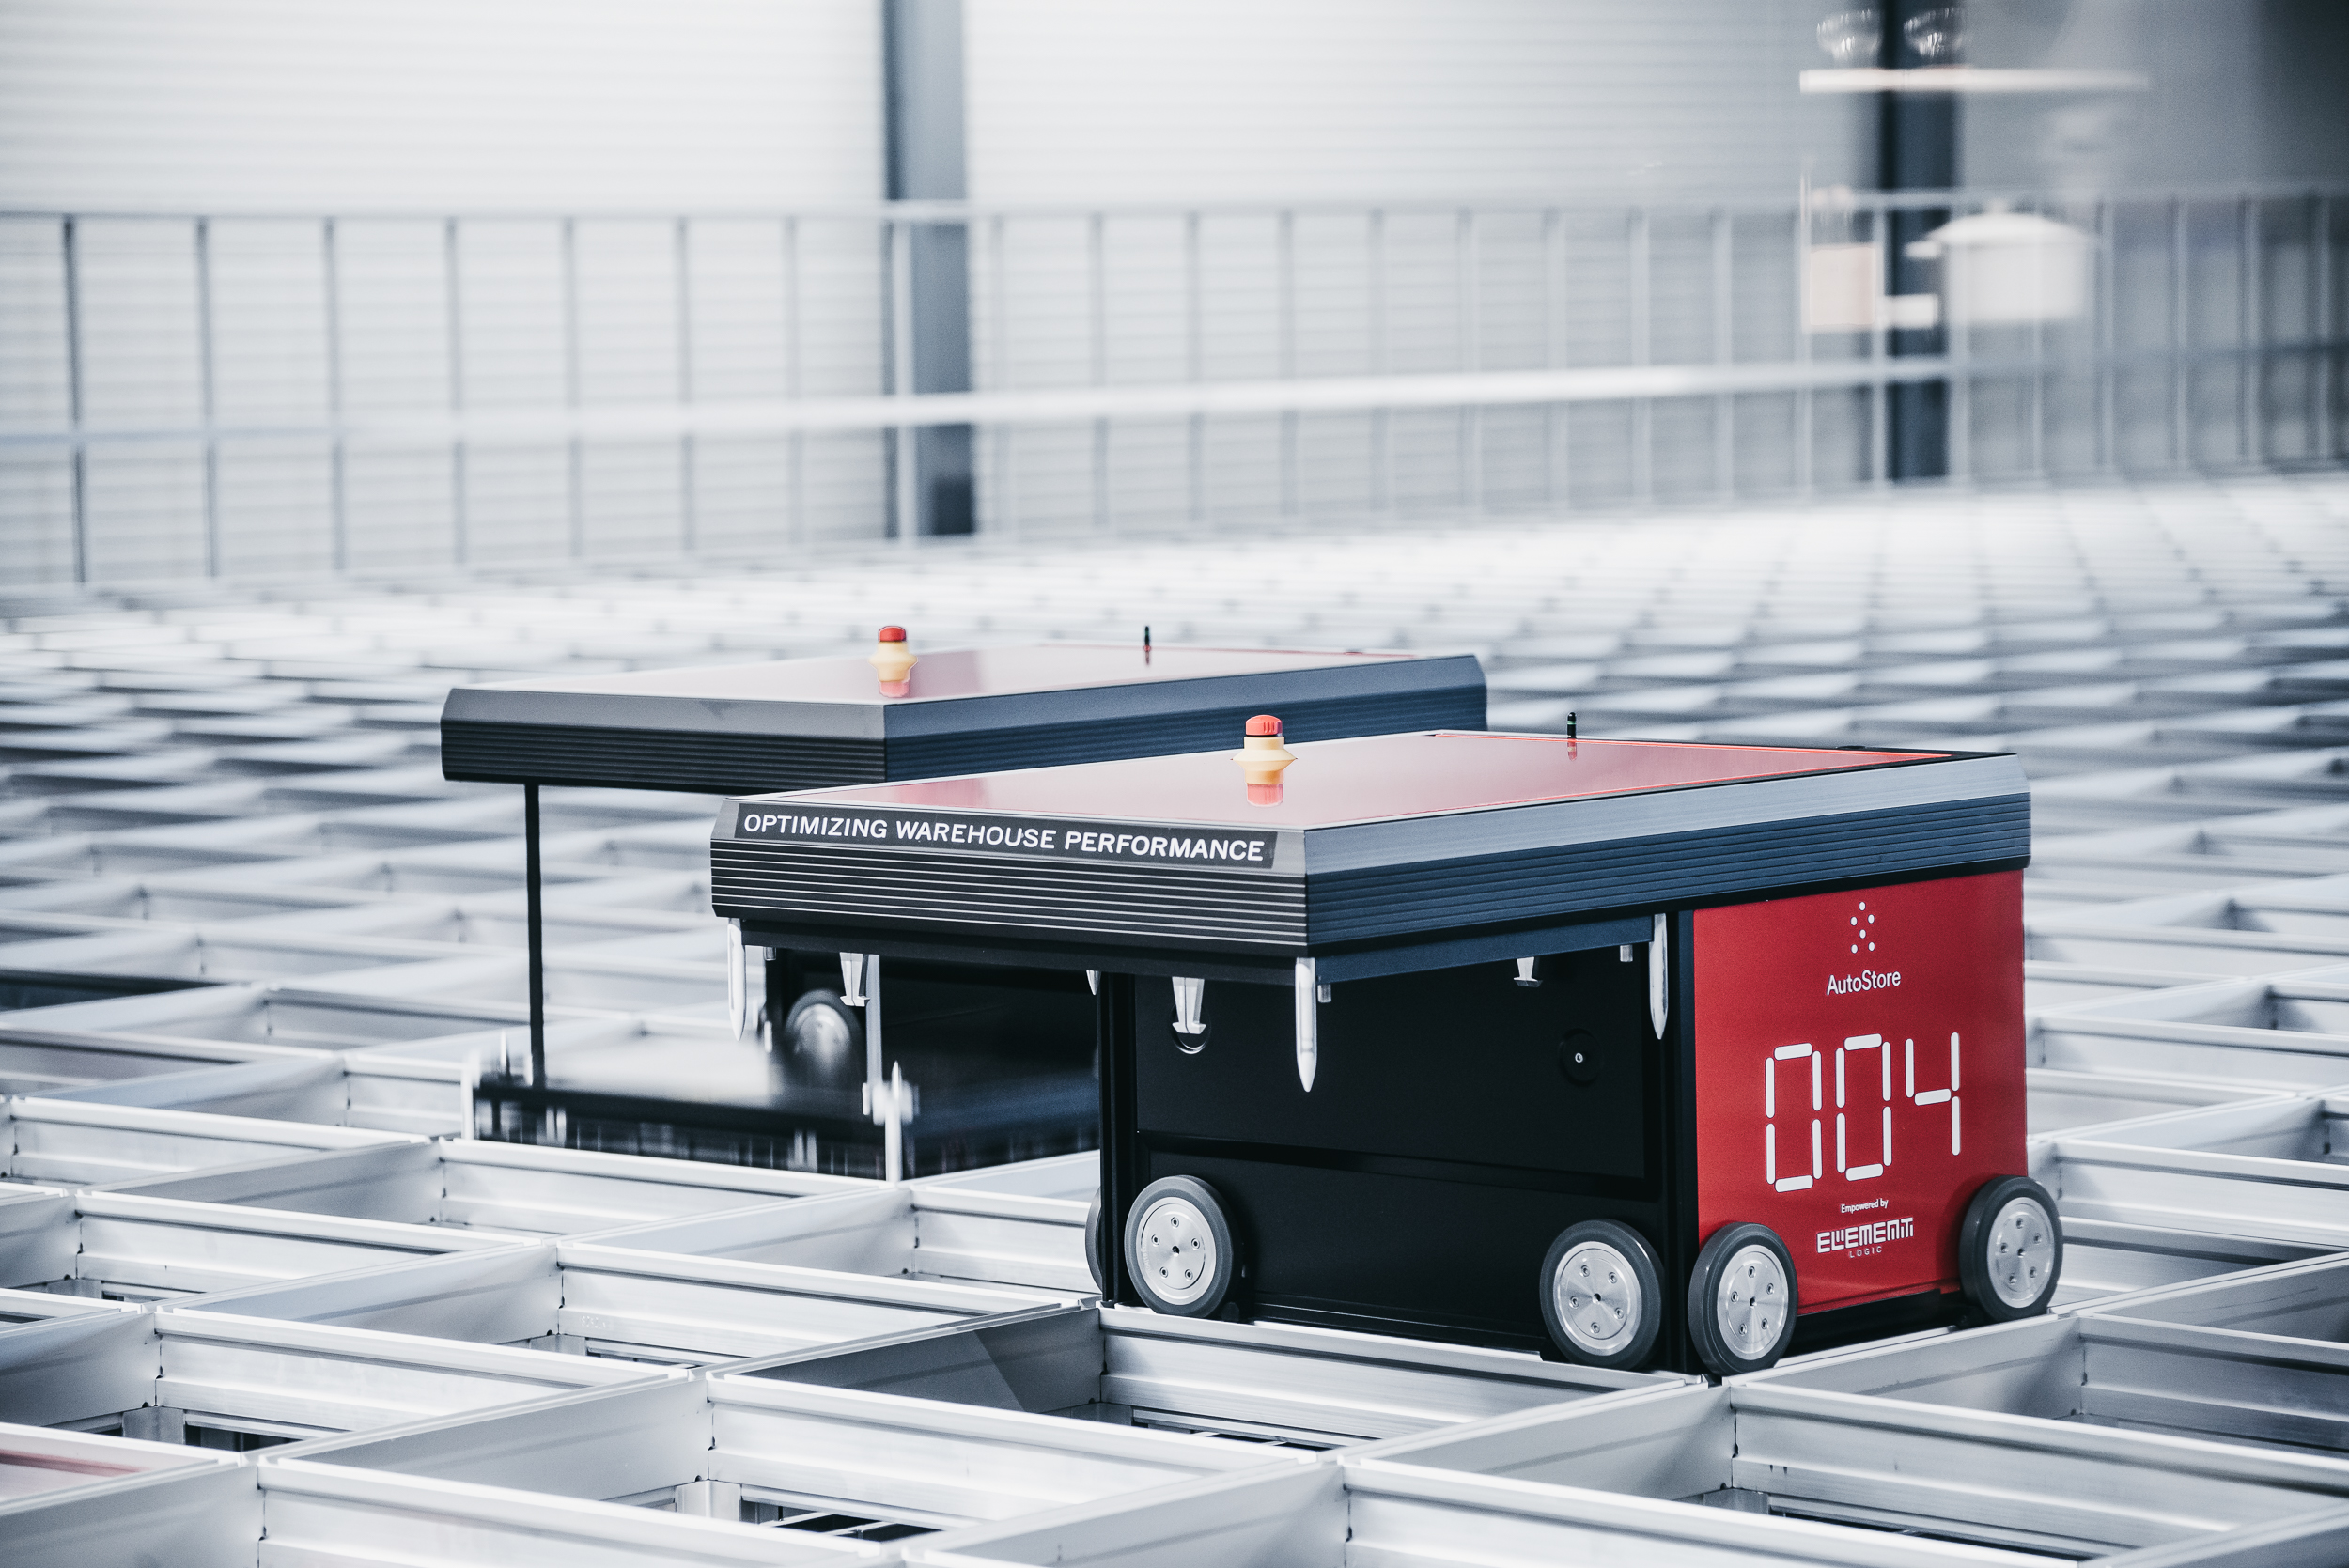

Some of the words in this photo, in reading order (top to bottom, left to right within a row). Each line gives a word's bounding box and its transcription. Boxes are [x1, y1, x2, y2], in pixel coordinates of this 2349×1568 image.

[744, 814, 888, 839] OPTIMIZING
[895, 820, 1057, 849] WAREHOUSE
[1064, 831, 1265, 862] PERFORMANCE
[1826, 969, 1902, 997] AutoStore
[1765, 1032, 1961, 1193] 004
[1840, 1199, 1879, 1215] Empowered
[1879, 1198, 1889, 1209] by
[1816, 1217, 1914, 1254] ELEMENT
[1848, 1245, 1883, 1259] LOGIC
